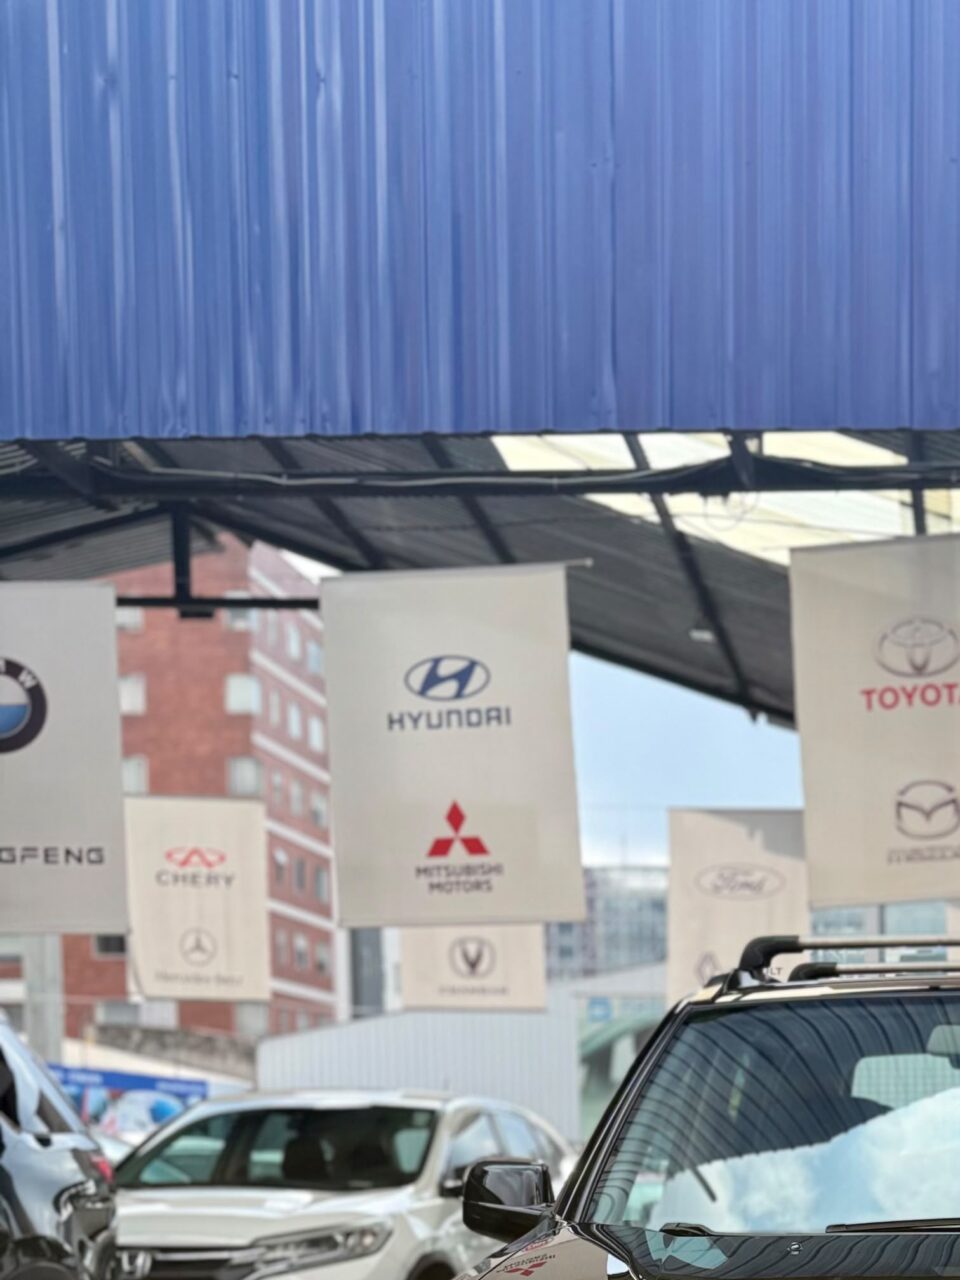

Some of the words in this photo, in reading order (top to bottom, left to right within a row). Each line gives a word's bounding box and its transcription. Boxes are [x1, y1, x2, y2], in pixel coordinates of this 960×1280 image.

[387, 706, 511, 731] HYUNDAI
[415, 863, 504, 878] MITSUBISHI
[155, 870, 235, 889] CHERY
[428, 879, 493, 894] MOTORS
